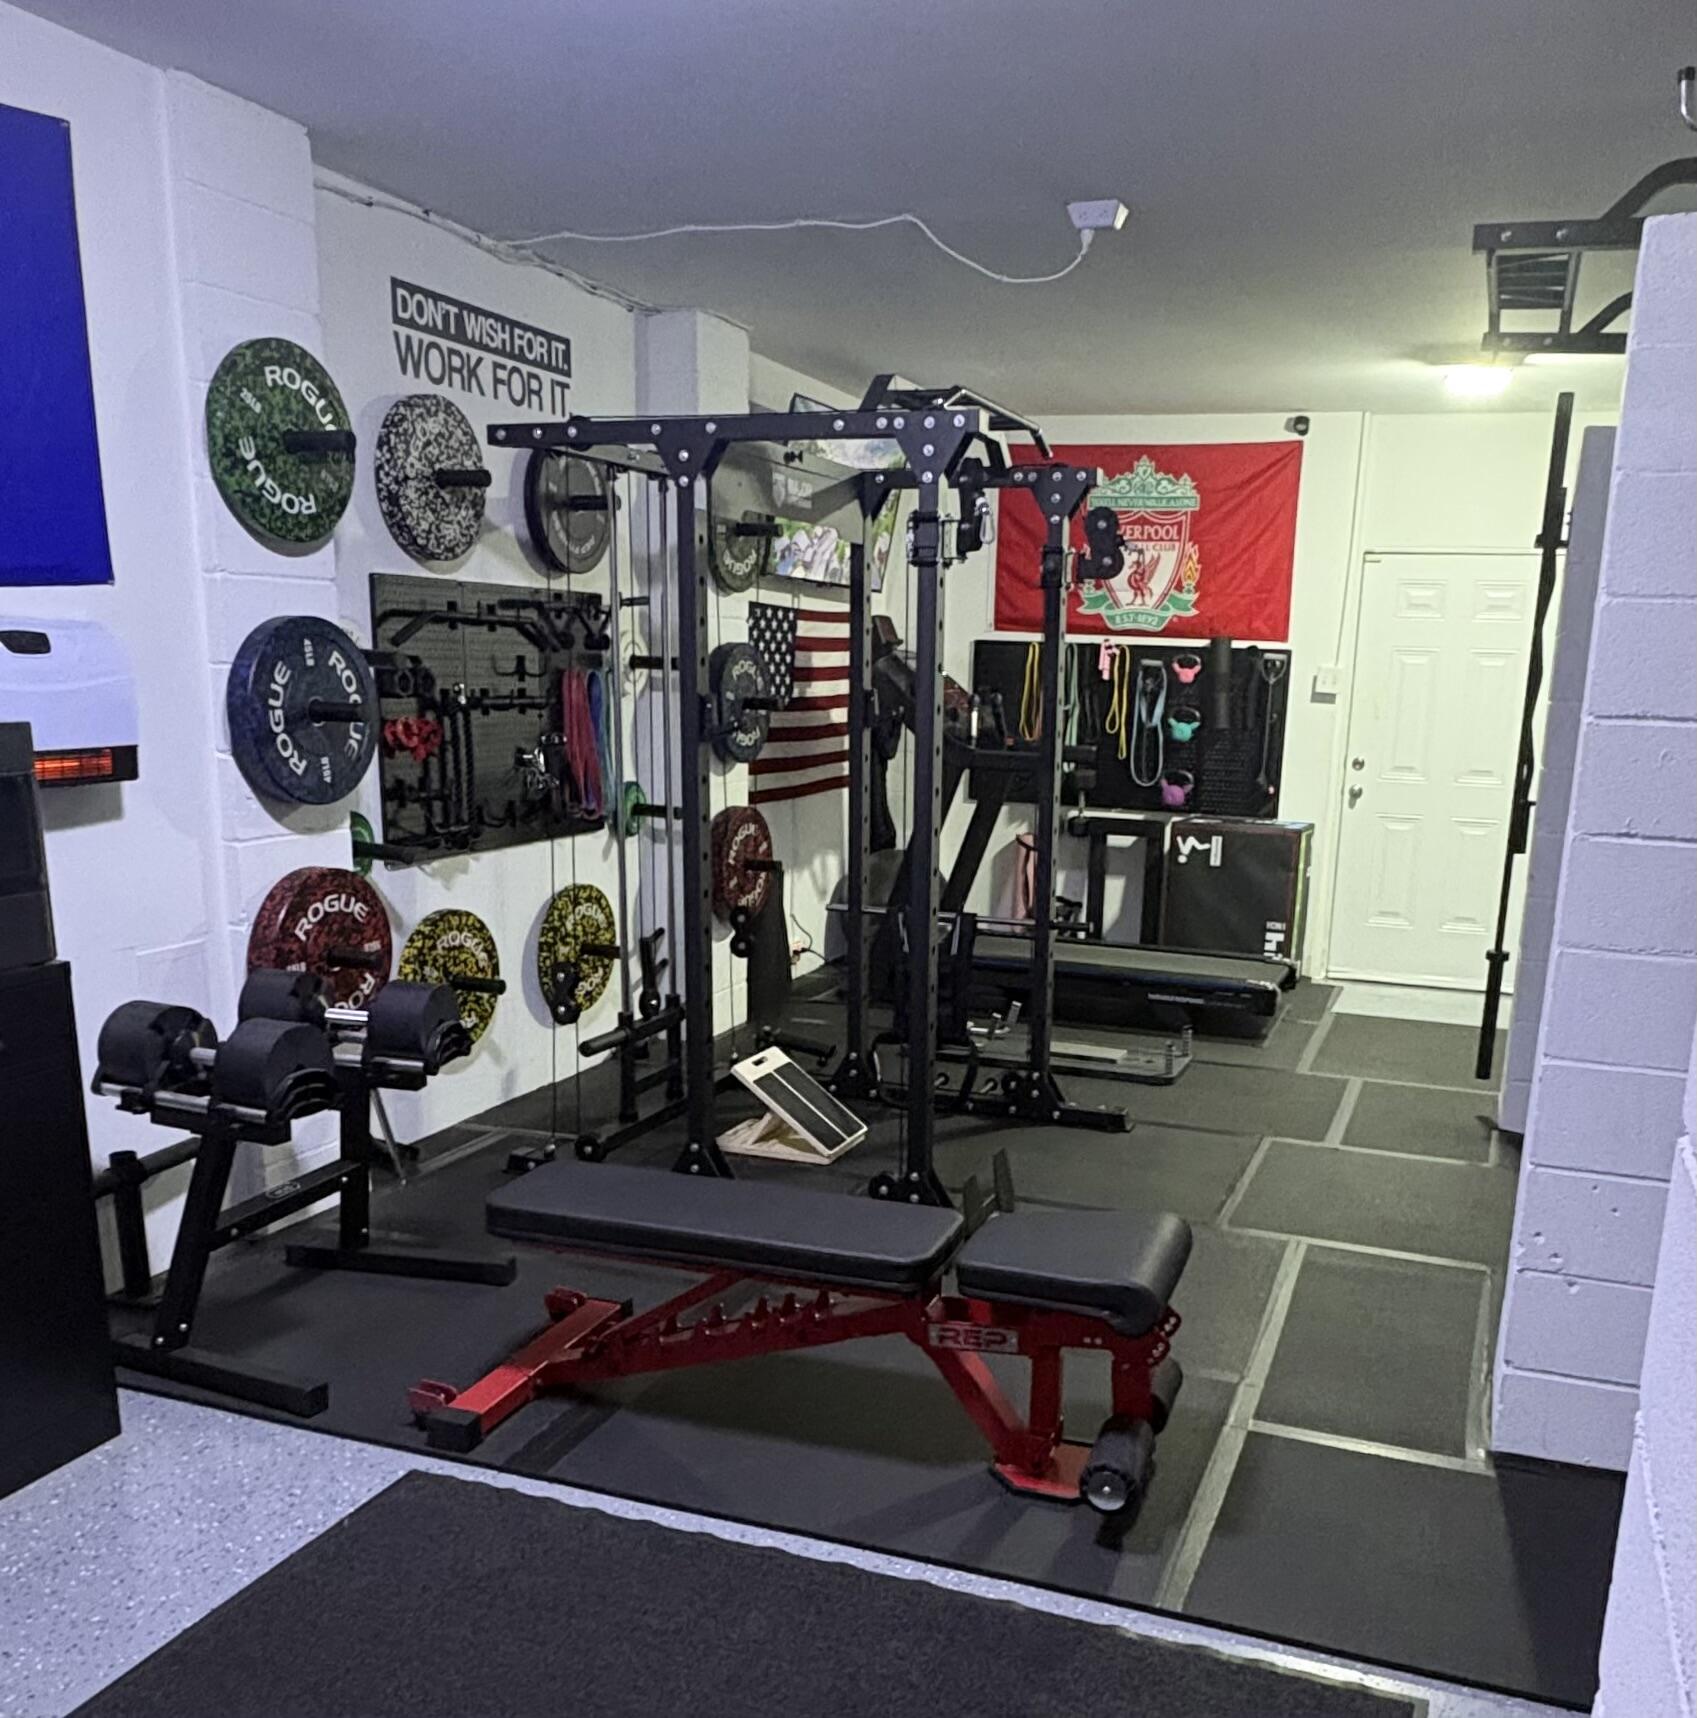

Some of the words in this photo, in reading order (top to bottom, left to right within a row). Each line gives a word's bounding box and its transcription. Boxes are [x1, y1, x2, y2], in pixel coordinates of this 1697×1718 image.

[396, 287, 459, 334] DON'T
[463, 310, 511, 352] WISH
[514, 327, 548, 364] FOR
[551, 340, 569, 370] IT.
[393, 330, 486, 397] WORK
[492, 360, 543, 412] FOR
[551, 378, 570, 418] IT
[238, 435, 318, 515] ROGUE
[268, 660, 307, 776] ROGUE
[294, 893, 369, 942] ROGUE
[937, 1327, 1008, 1348] REP
